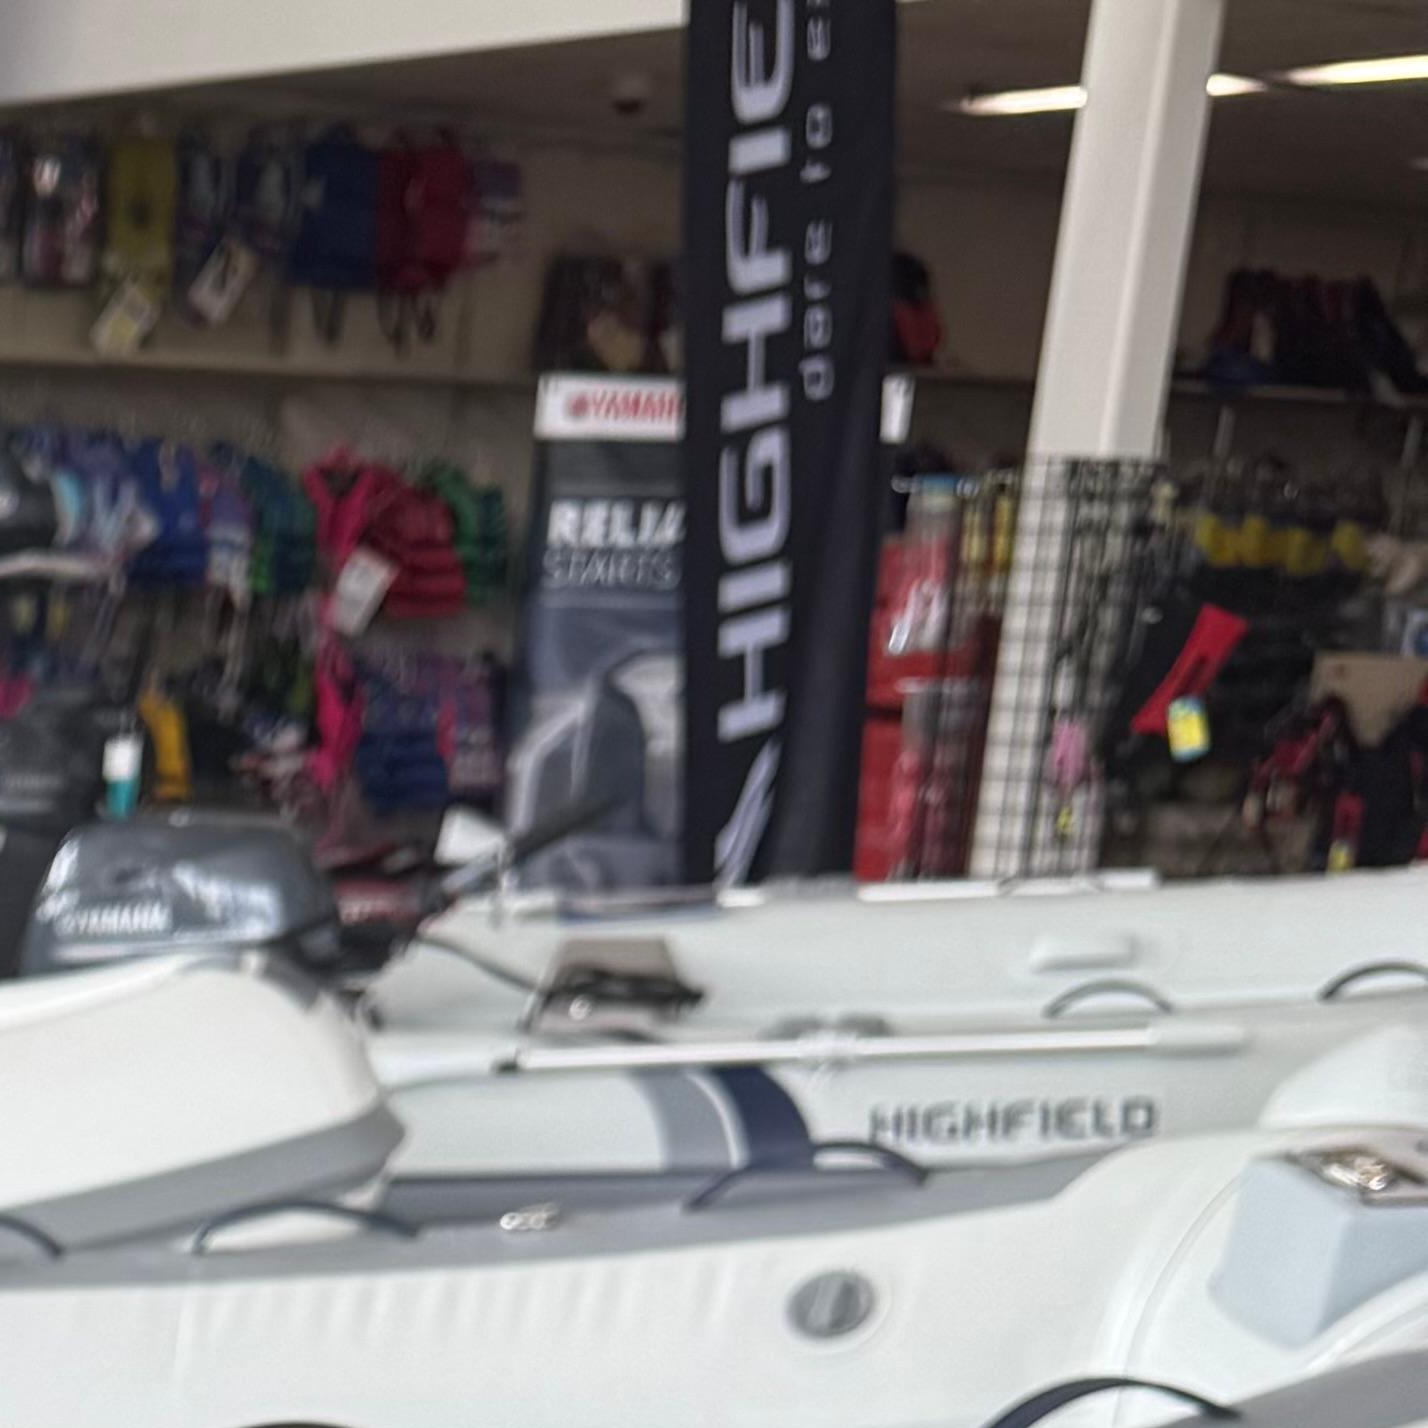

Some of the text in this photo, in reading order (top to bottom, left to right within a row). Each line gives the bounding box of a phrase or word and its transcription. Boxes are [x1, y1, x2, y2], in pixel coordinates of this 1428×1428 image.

[593, 388, 684, 422] YAMAH
[74, 902, 173, 937] YAMAHA
[870, 1097, 1158, 1143] HIGHFIELD
